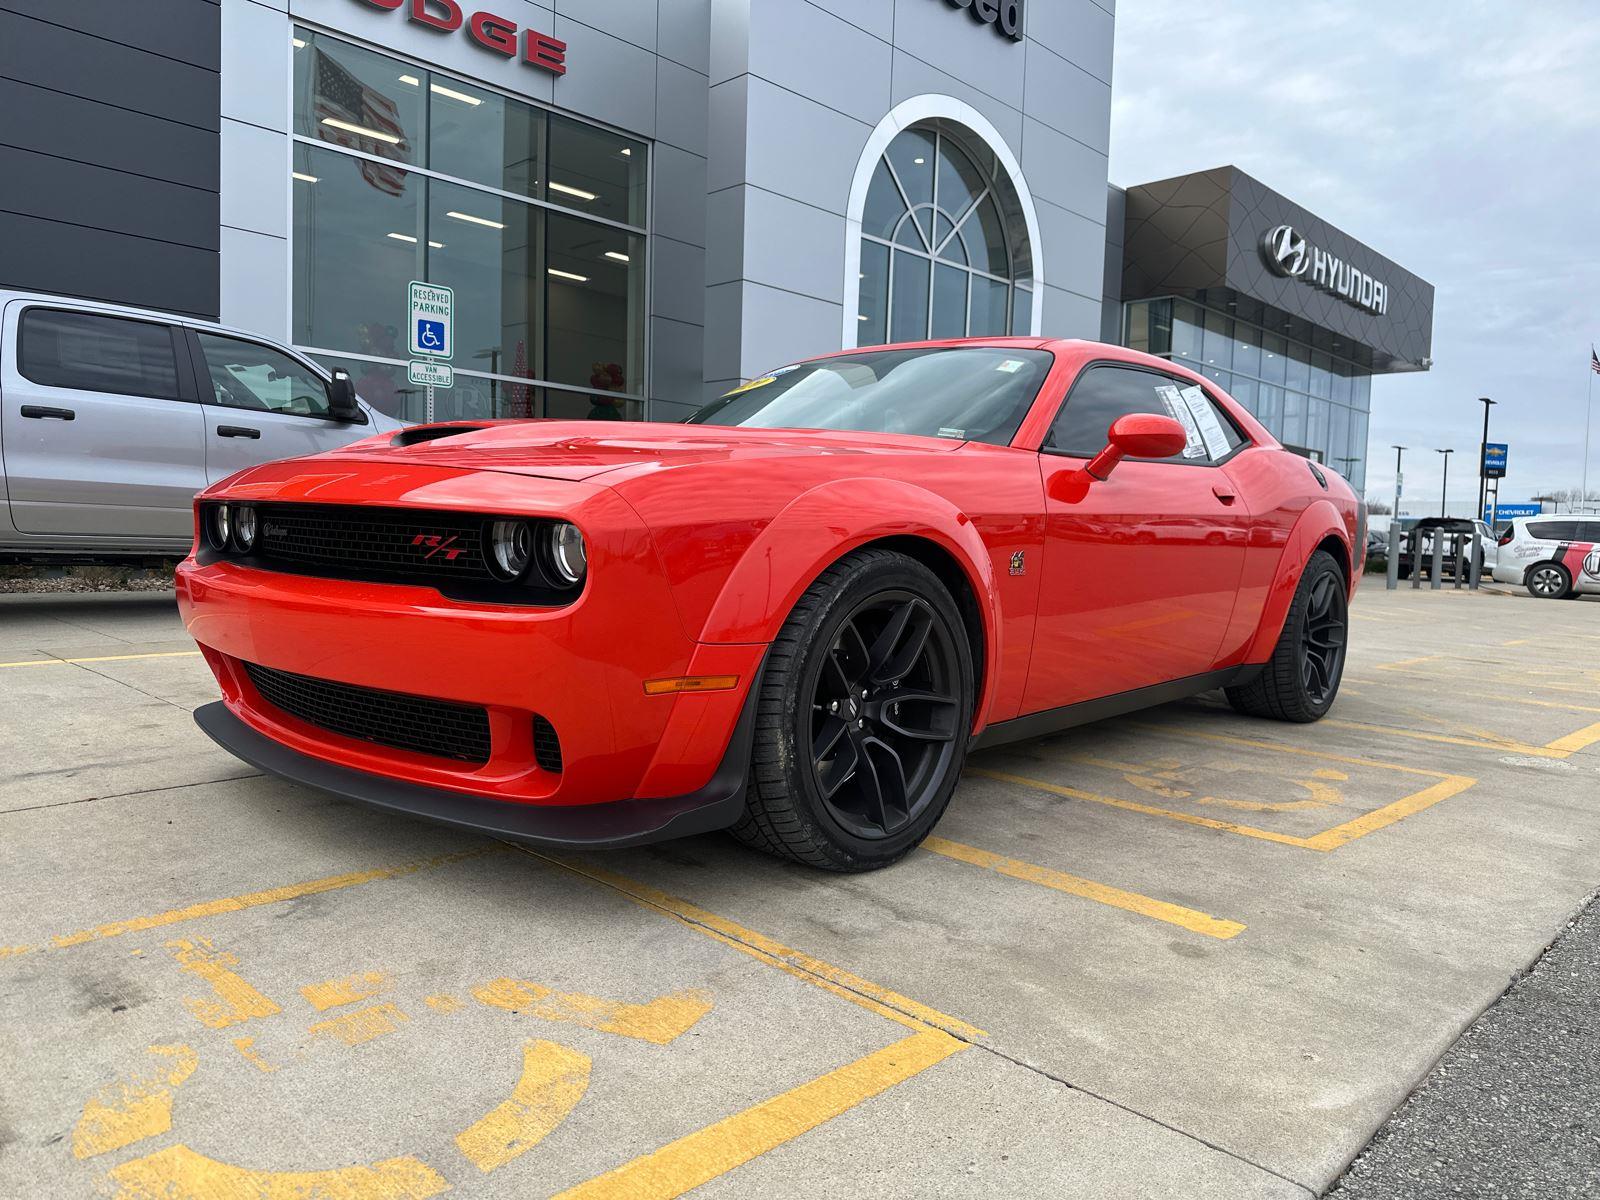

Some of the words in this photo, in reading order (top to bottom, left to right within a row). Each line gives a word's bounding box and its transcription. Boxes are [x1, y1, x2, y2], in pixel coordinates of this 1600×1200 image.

[349, 0, 567, 77] DGE
[1311, 246, 1388, 316] HYUNDAI
[413, 288, 449, 304] RESERVED
[413, 301, 450, 316] PARKING
[424, 365, 438, 373] VAN
[411, 372, 450, 384] ACCESSIBLE
[410, 534, 468, 561] R/T
